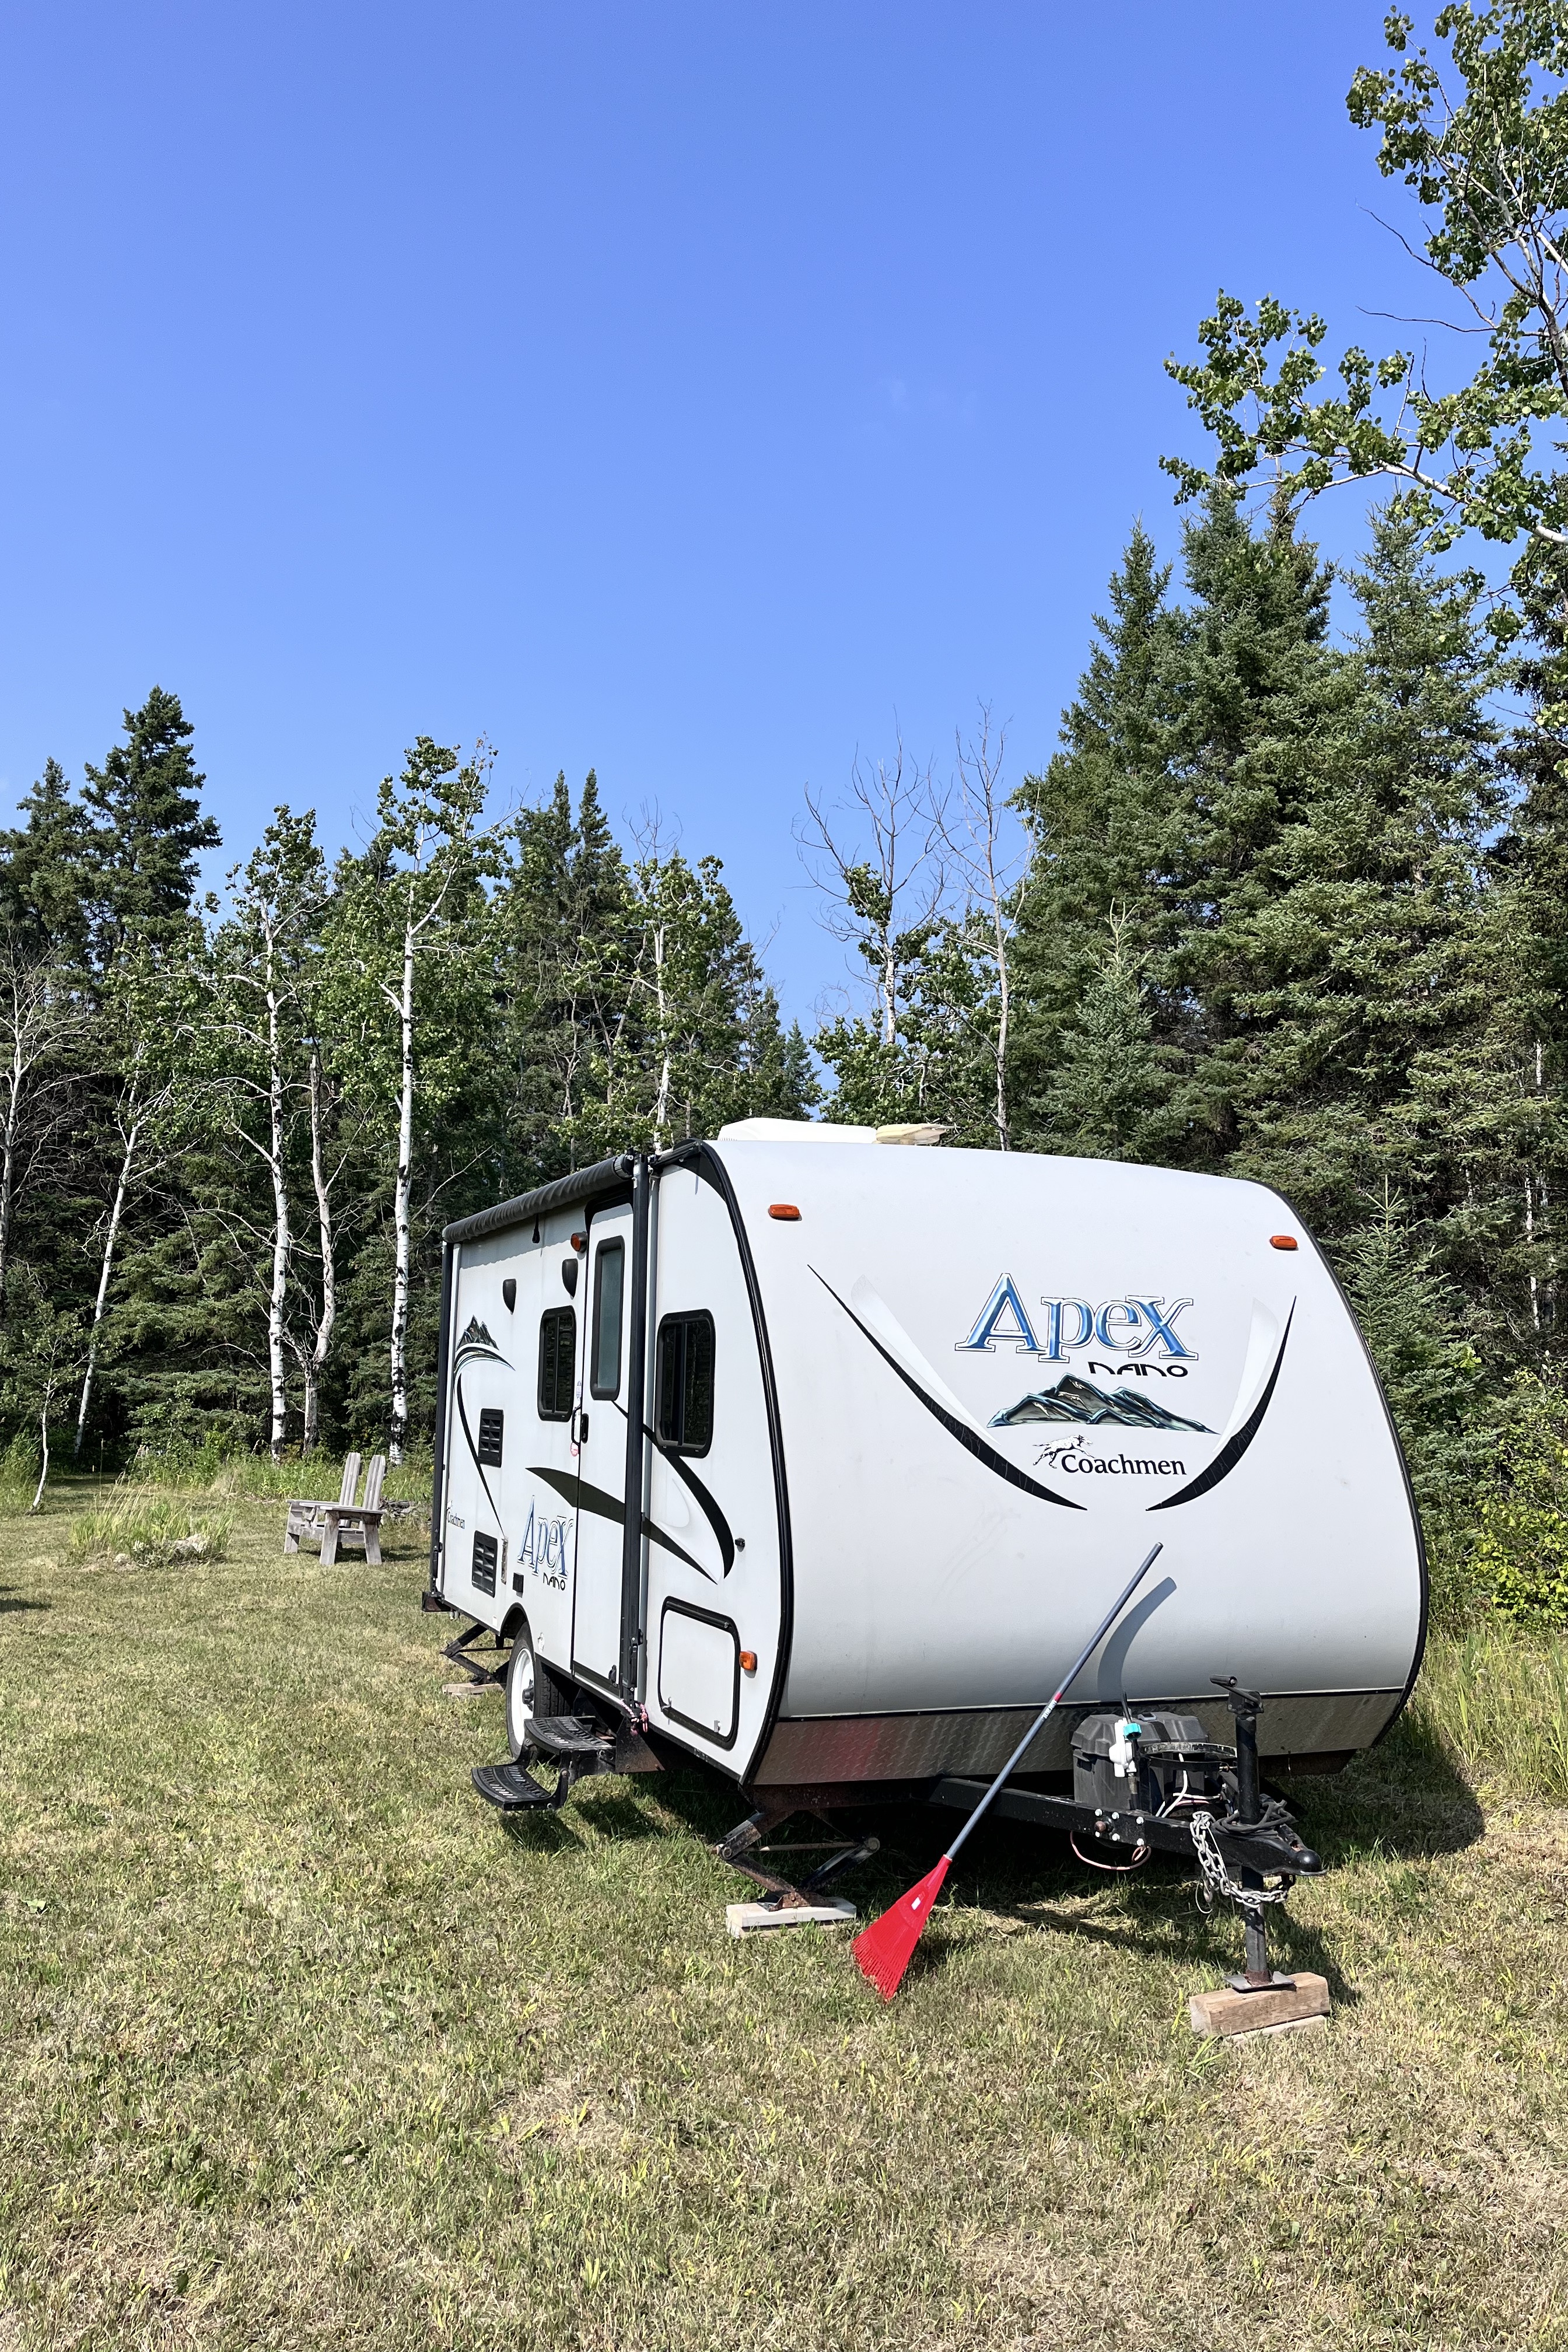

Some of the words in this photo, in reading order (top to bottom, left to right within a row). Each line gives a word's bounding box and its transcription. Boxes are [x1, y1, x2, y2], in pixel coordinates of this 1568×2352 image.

[954, 1273, 1198, 1363] Apex
[1061, 1454, 1186, 1475] Coachmen
[517, 1495, 573, 1579] Apex
